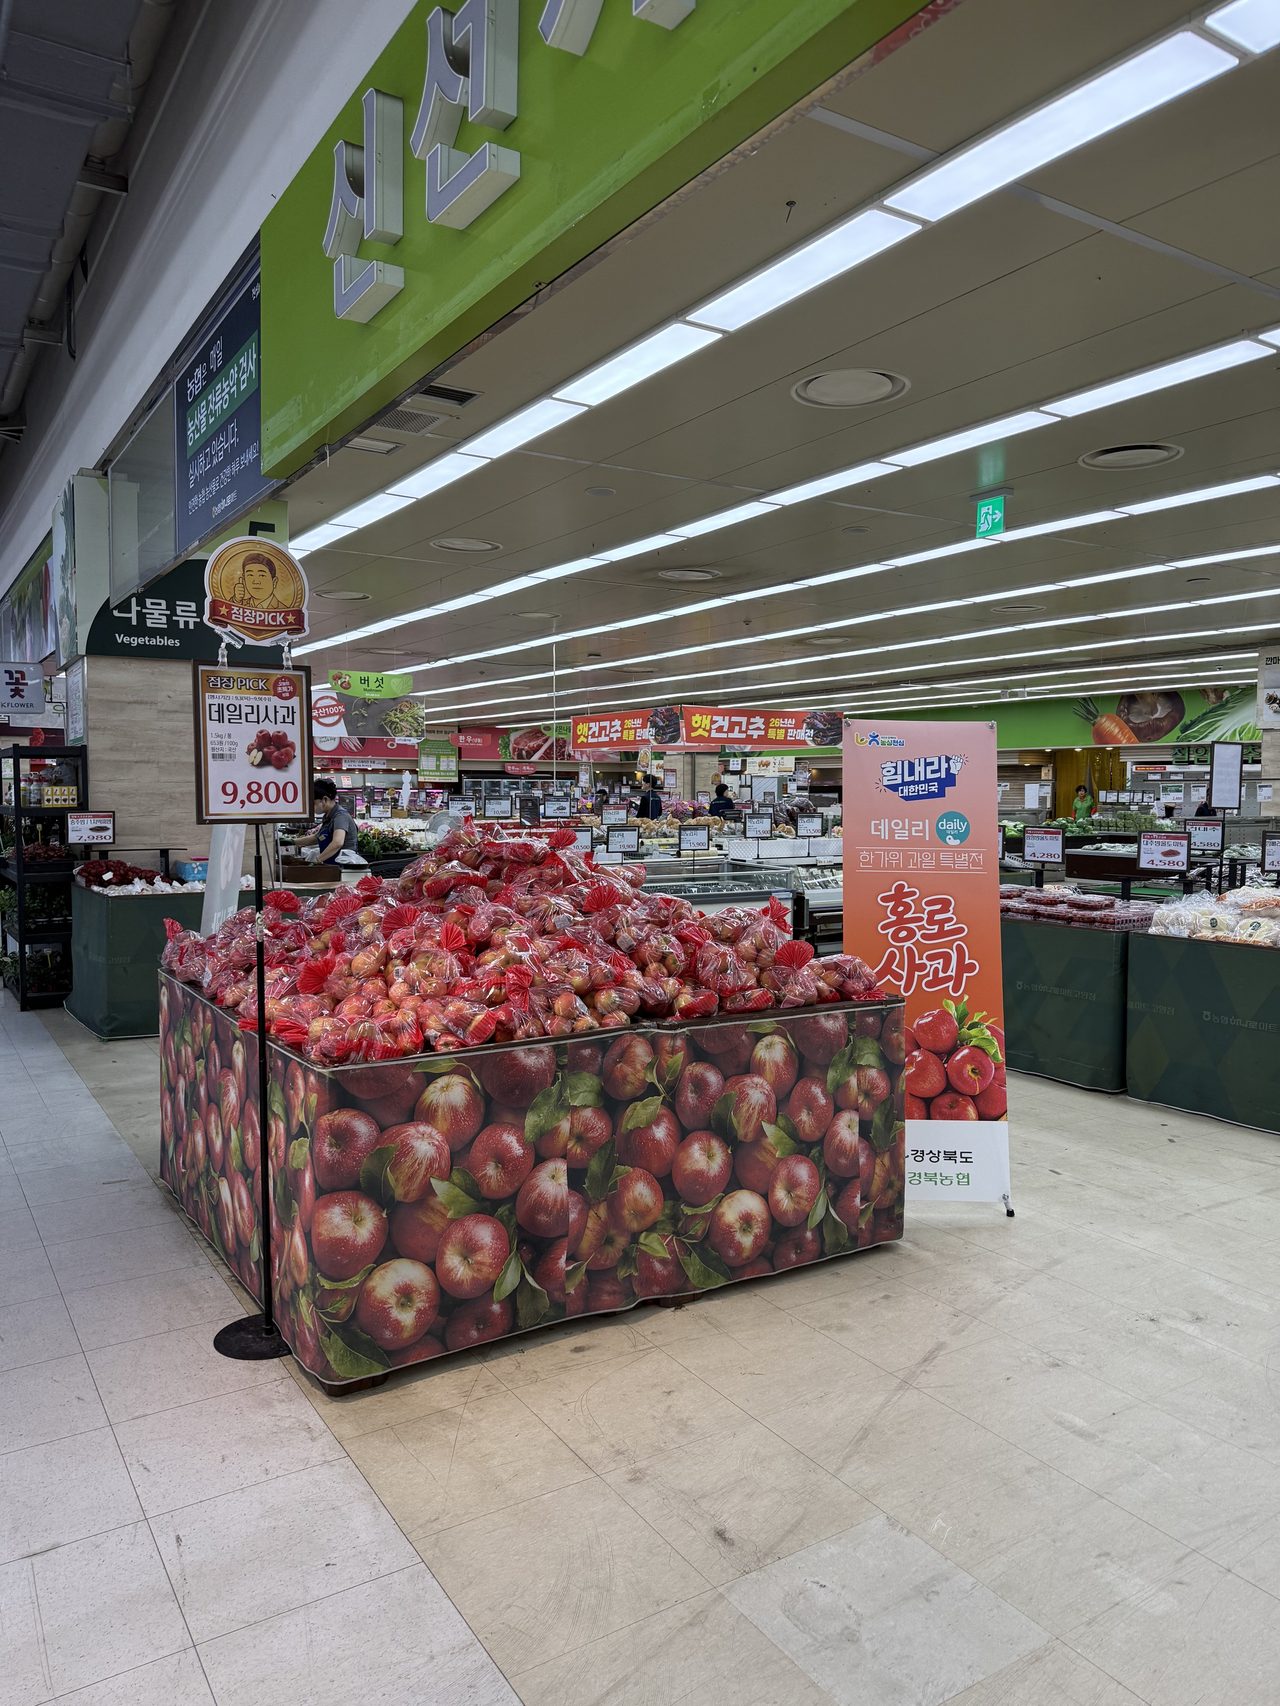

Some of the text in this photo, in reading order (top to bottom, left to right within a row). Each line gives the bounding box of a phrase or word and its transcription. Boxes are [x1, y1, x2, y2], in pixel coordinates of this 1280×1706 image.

[187, 335, 223, 403] 농협은 매일
[187, 341, 257, 447] 농산물 잔류농약 검사
[188, 417, 240, 489] 실시하고 있습니다.
[112, 596, 201, 630] 나물류
[230, 606, 286, 626] 점장PICK
[115, 633, 181, 648] Vegetables
[4, 669, 29, 699] 꽃
[207, 675, 269, 691] 점장 PICK
[207, 702, 297, 726] 데일리사과
[312, 704, 346, 719] 국산100%
[576, 719, 622, 744] 햇건고추
[623, 717, 642, 729] 26년산
[691, 714, 765, 739] 햇건고추
[769, 717, 795, 729] 26년산
[622, 729, 636, 742] 특별
[767, 726, 814, 741] 특별 판매전
[880, 754, 949, 786] 힘내라
[221, 781, 299, 809] 9,800
[898, 782, 939, 797] 대한민국
[77, 834, 112, 842] 7,980
[871, 818, 968, 841] 데일리 daily
[1190, 841, 1220, 849] 4,580
[860, 851, 984, 870] 한가위 과일 특별전
[1029, 852, 1061, 860] 4,280
[1146, 859, 1185, 868] 4,580
[877, 881, 969, 946] 홍로
[872, 941, 980, 997] 사과
[910, 1149, 974, 1164] 경상북도
[907, 1171, 971, 1187] 경북농협
